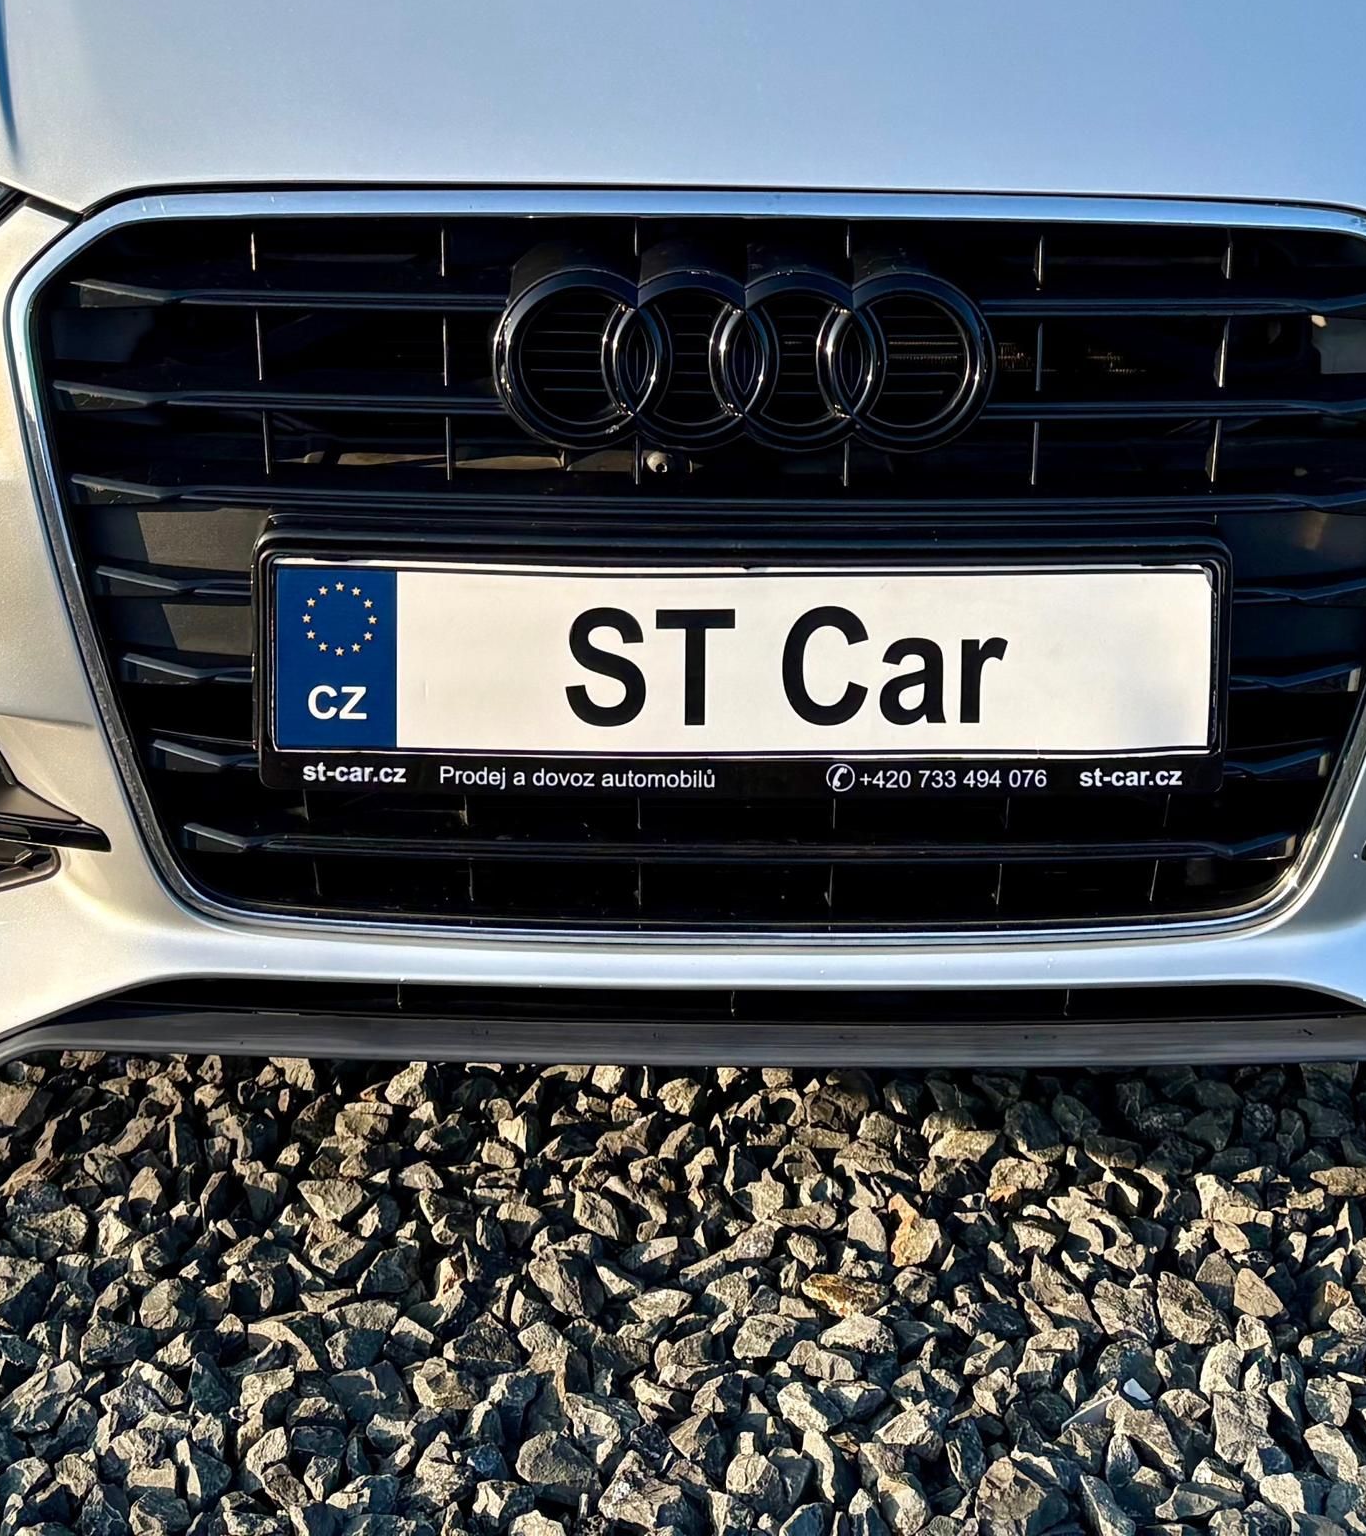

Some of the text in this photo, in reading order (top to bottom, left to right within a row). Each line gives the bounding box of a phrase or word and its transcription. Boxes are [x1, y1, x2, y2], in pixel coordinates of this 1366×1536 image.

[566, 606, 1009, 726] ST Car
[308, 685, 367, 720] CZ
[302, 762, 1183, 790] st-car.cz Prodej a dovoz automobilů +420 733 494 076 st-car.cz
